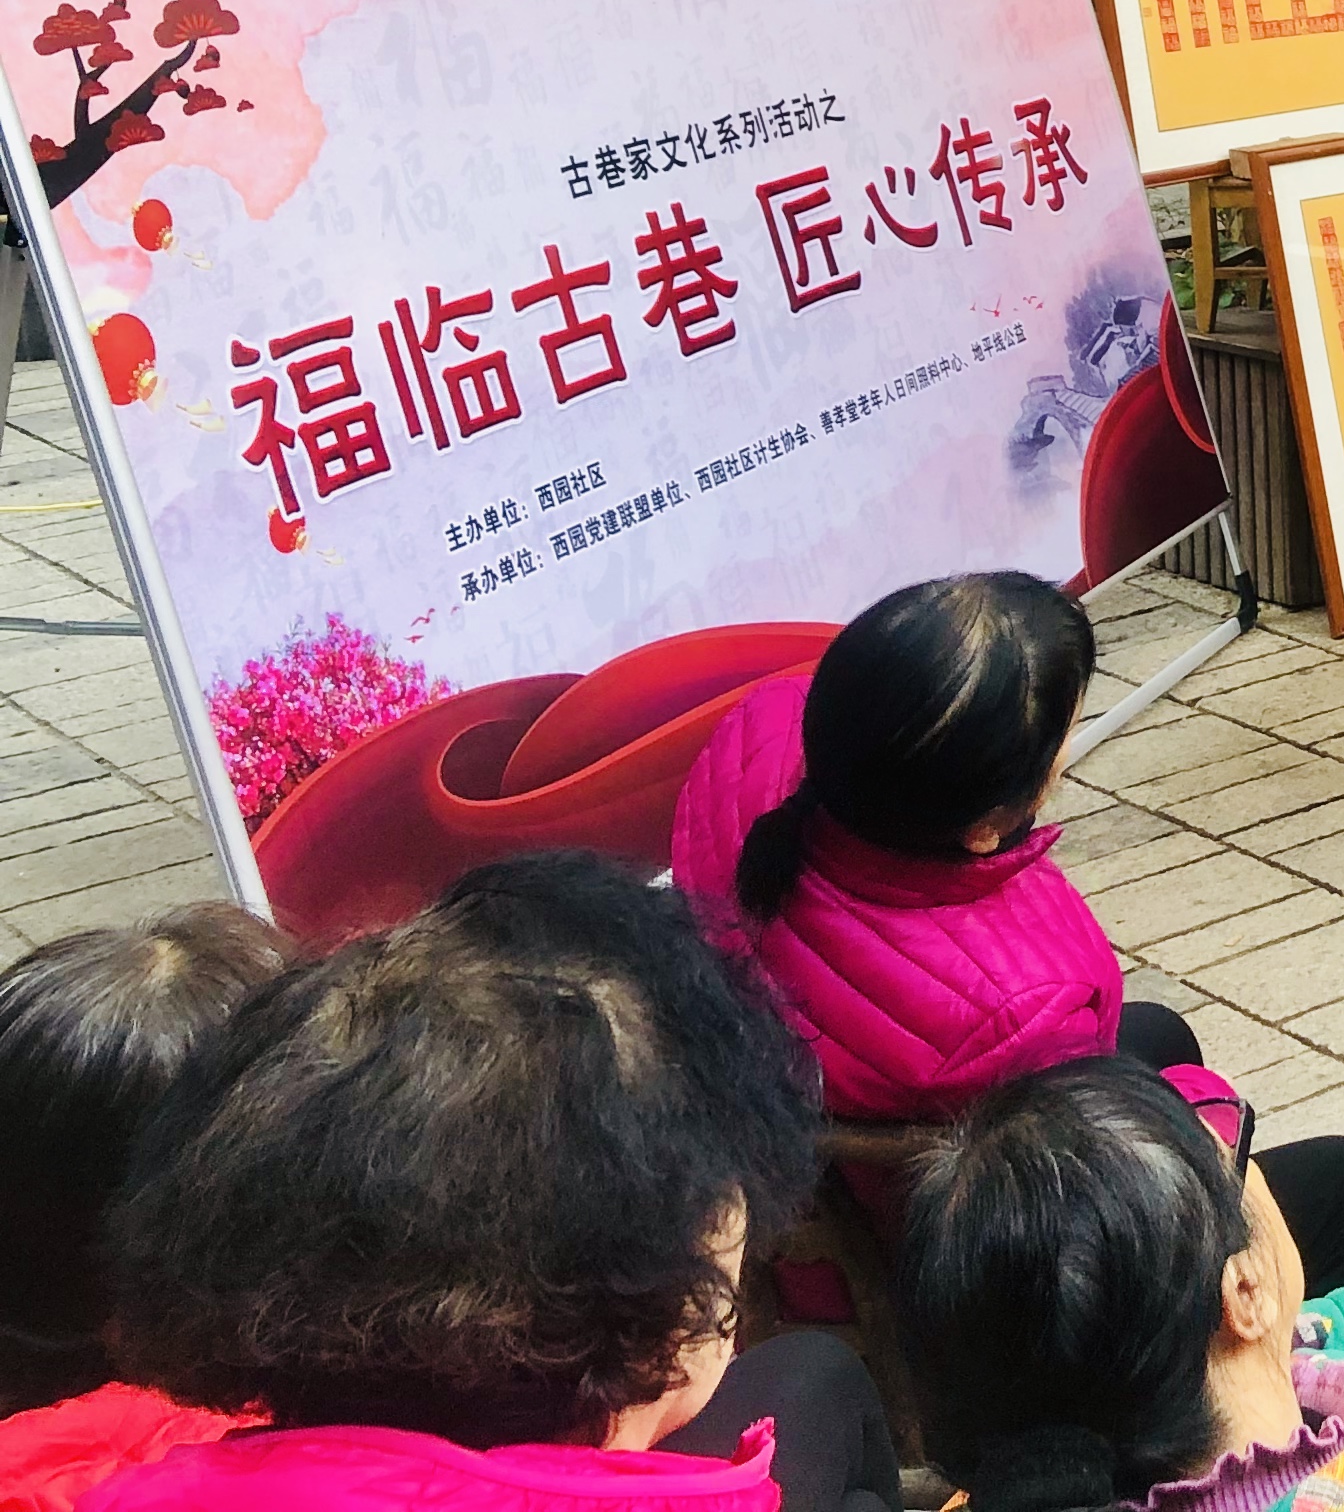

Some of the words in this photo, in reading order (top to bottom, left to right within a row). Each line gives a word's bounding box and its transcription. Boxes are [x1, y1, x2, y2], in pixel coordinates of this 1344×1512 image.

[560, 88, 846, 200] 古巷家文化系列活动之
[230, 201, 739, 516] 福临古巷
[755, 97, 1090, 315] 匠心传承
